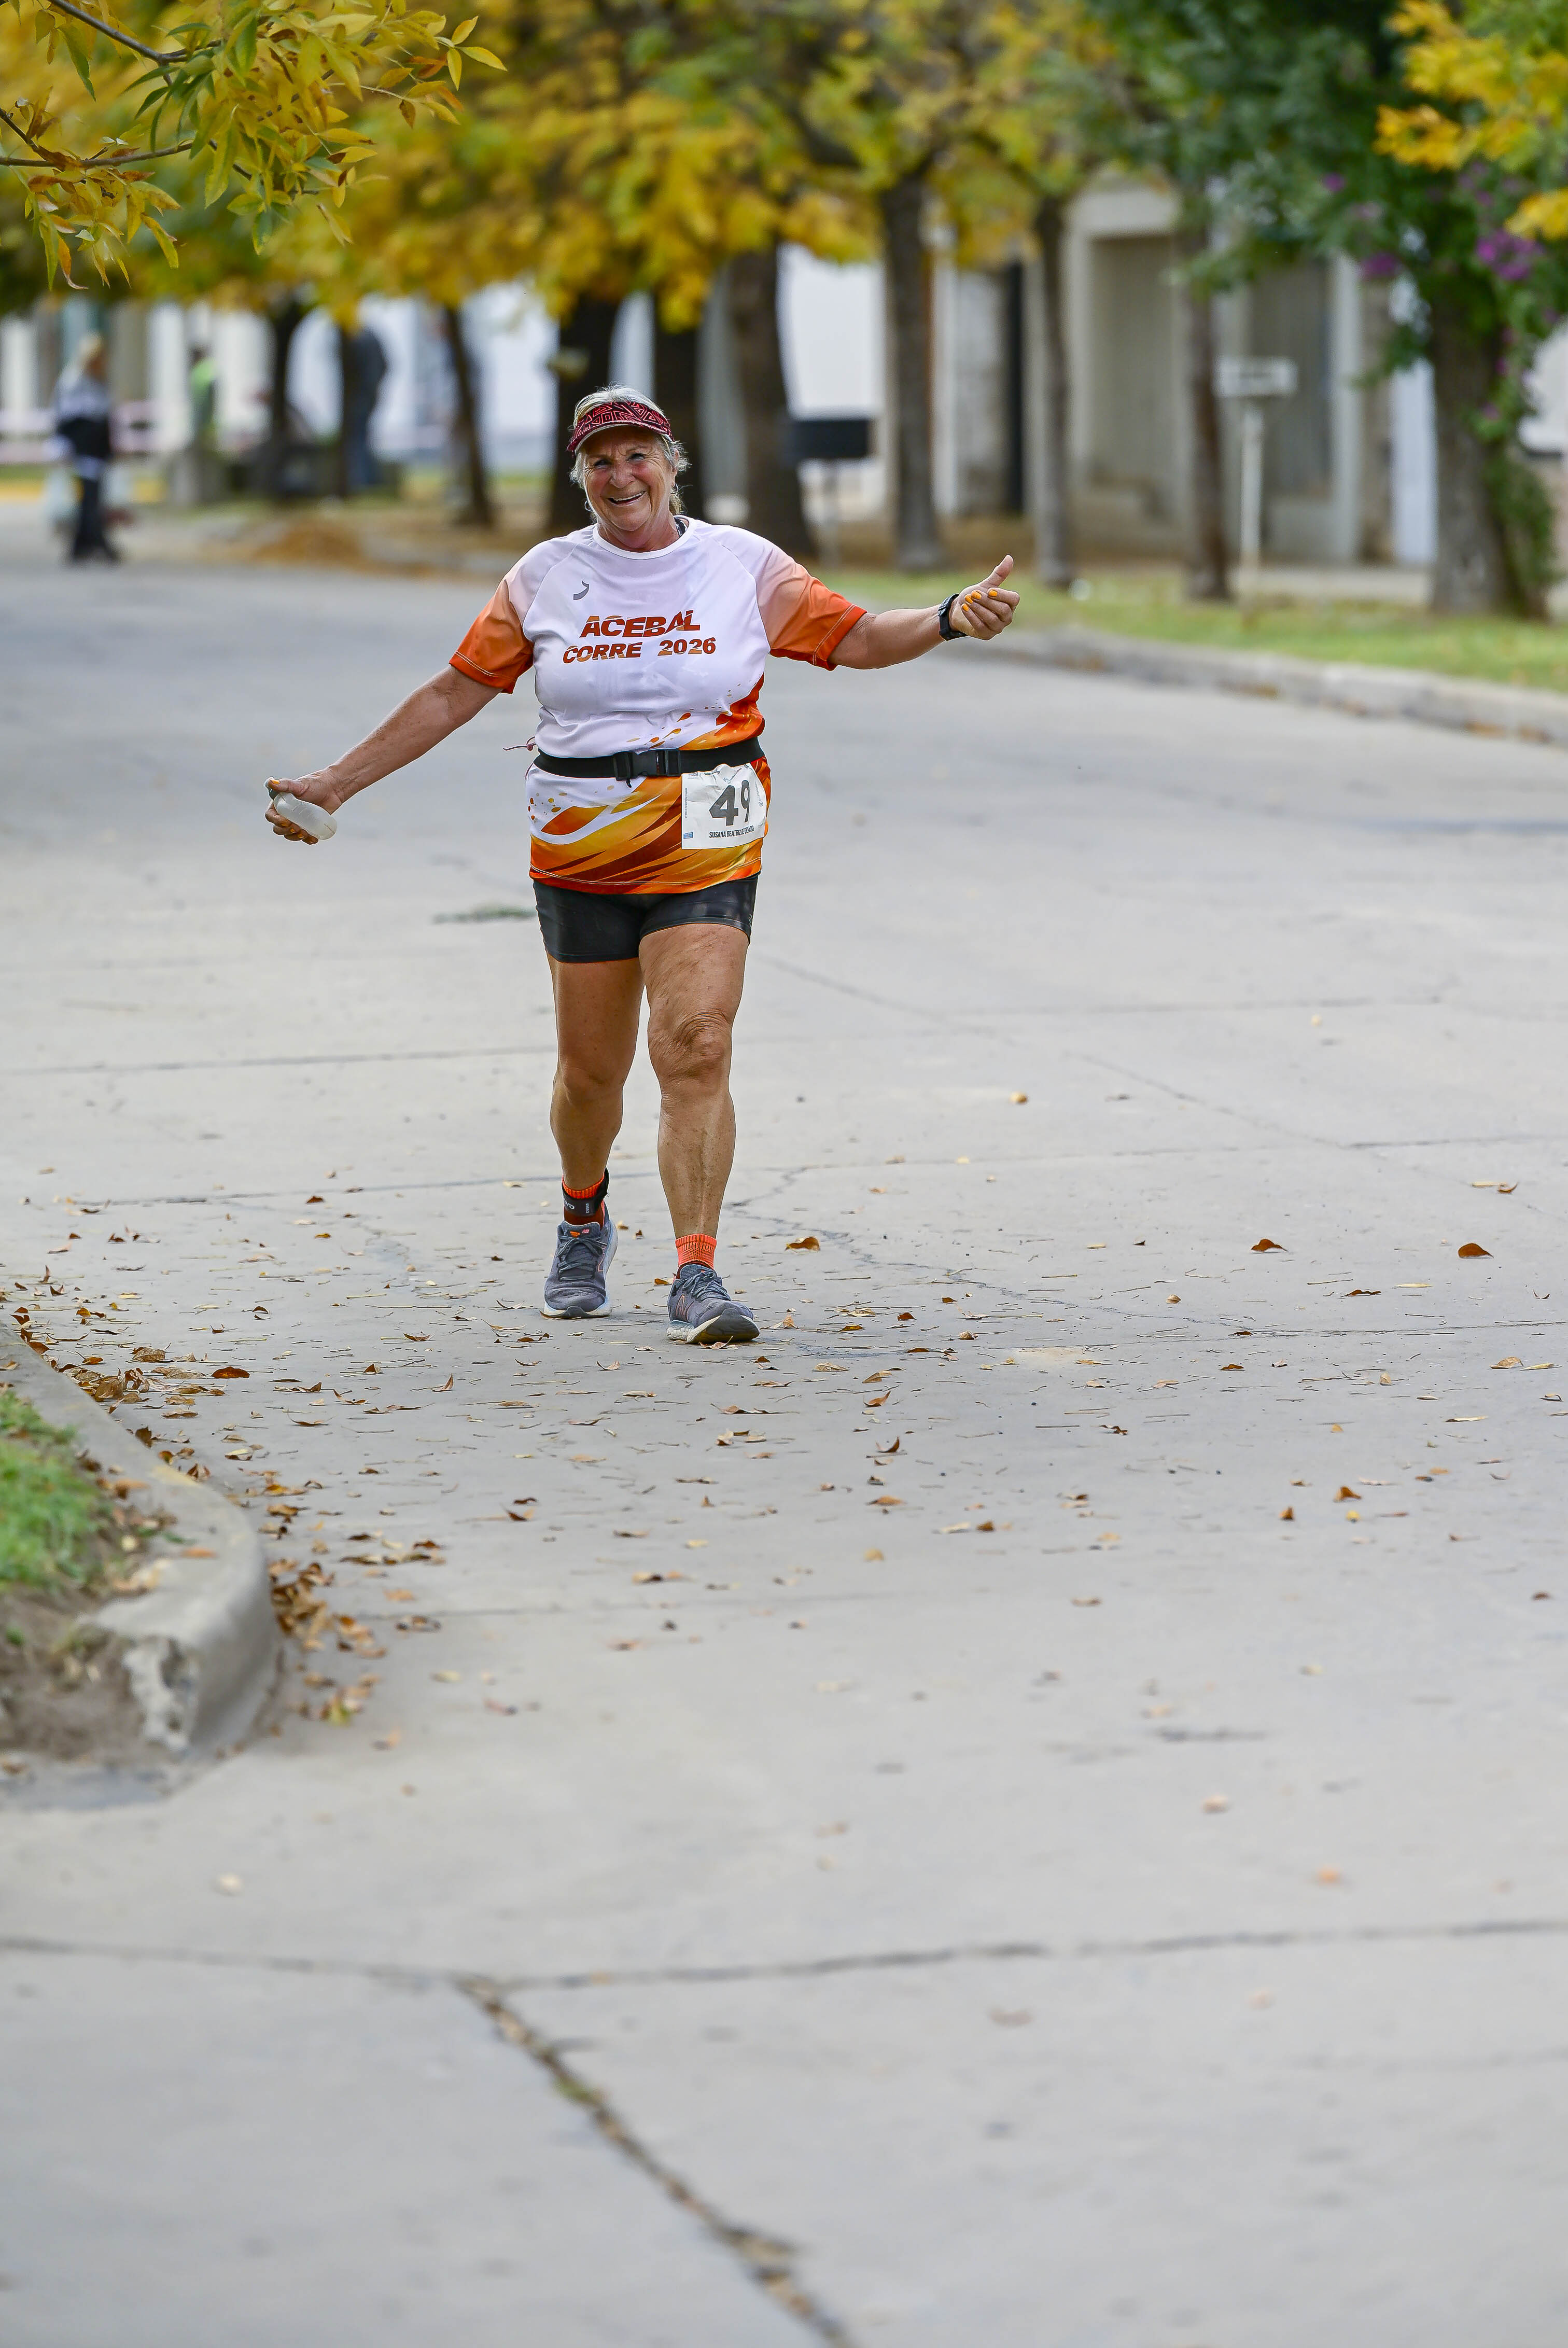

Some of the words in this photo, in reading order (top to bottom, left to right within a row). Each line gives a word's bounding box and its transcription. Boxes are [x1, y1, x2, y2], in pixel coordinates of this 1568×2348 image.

[580, 610, 701, 638] ACEBAL
[563, 641, 642, 664] CORRE
[657, 637, 716, 656] 2026
[709, 780, 750, 826] 49
